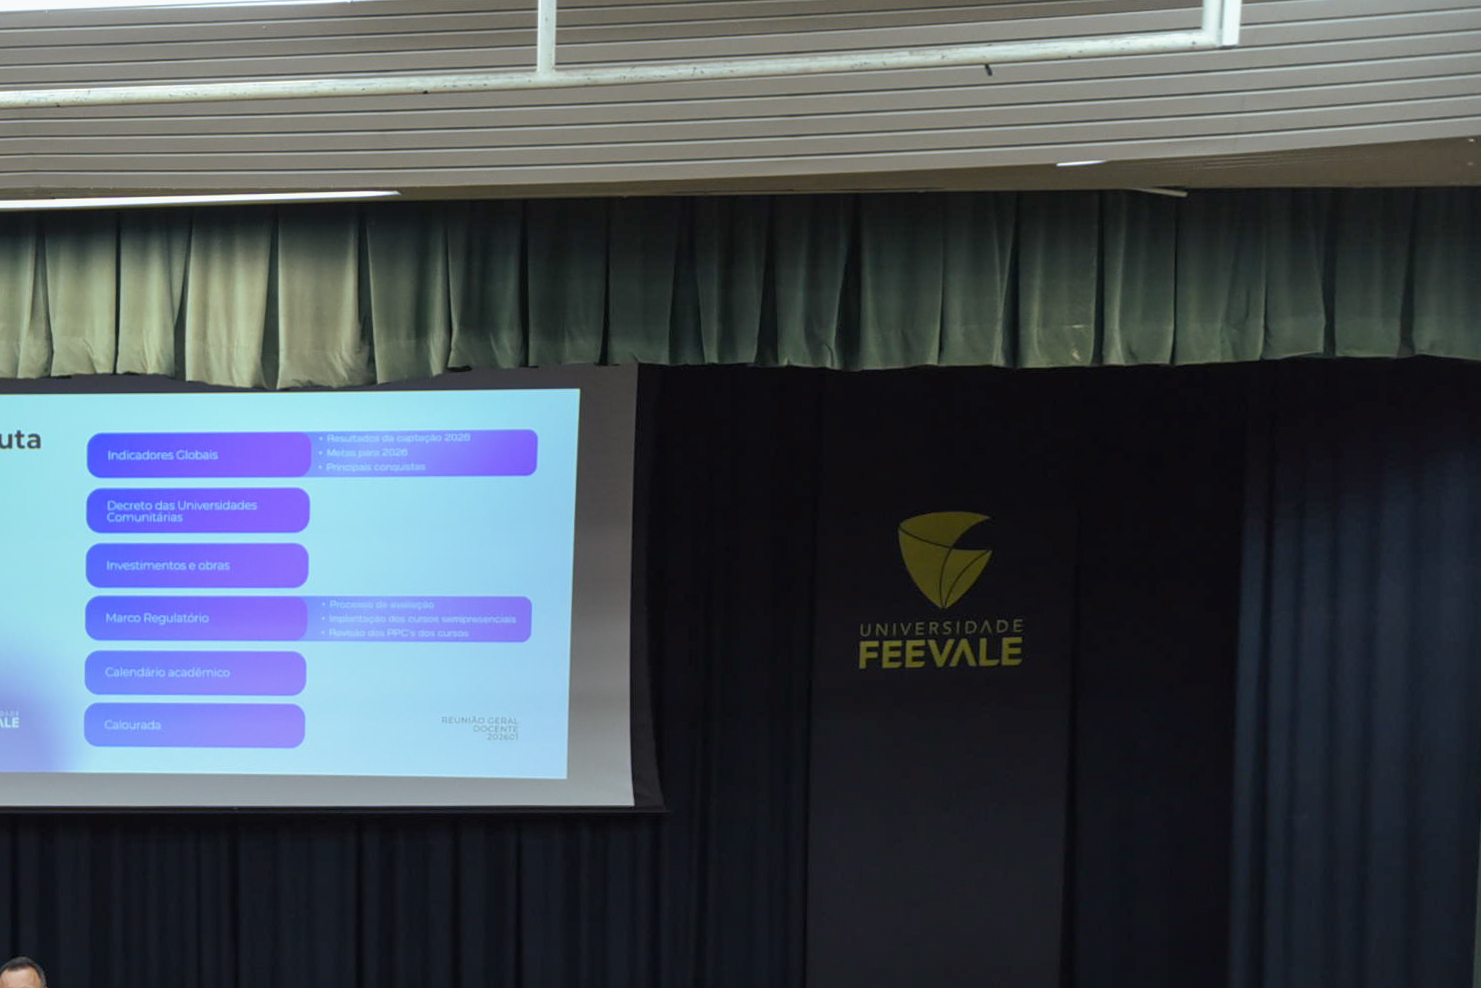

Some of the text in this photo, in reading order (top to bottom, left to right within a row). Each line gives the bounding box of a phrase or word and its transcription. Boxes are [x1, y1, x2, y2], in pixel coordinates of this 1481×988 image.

[326, 433, 380, 443] Resultados
[382, 433, 395, 443] da
[396, 433, 442, 445] captação
[107, 449, 219, 461] Indicadores Globais
[326, 447, 408, 460] Metas para 2026
[326, 462, 426, 474] Principais conquistas
[107, 500, 257, 511] Decreto das Universidades
[106, 511, 183, 523] Comunitárias
[106, 560, 231, 571] Investimentos e obras
[329, 600, 374, 610] Processo
[376, 600, 389, 610] de
[105, 612, 210, 626] Marco Regulatório
[329, 614, 517, 626] Implantação dos cursos semipresenciais
[329, 628, 366, 638] Revisão
[367, 628, 386, 638] dos
[418, 628, 436, 638] dos
[437, 629, 469, 639] cursos
[859, 618, 1024, 638] UNIVERSIDADE
[858, 636, 1023, 670] FEEVALE
[104, 666, 231, 678] Calendário acadêmico
[104, 719, 162, 731] Calourada
[441, 715, 519, 725] REUNIÃO GERAL
[473, 725, 519, 733] DOCENTE
